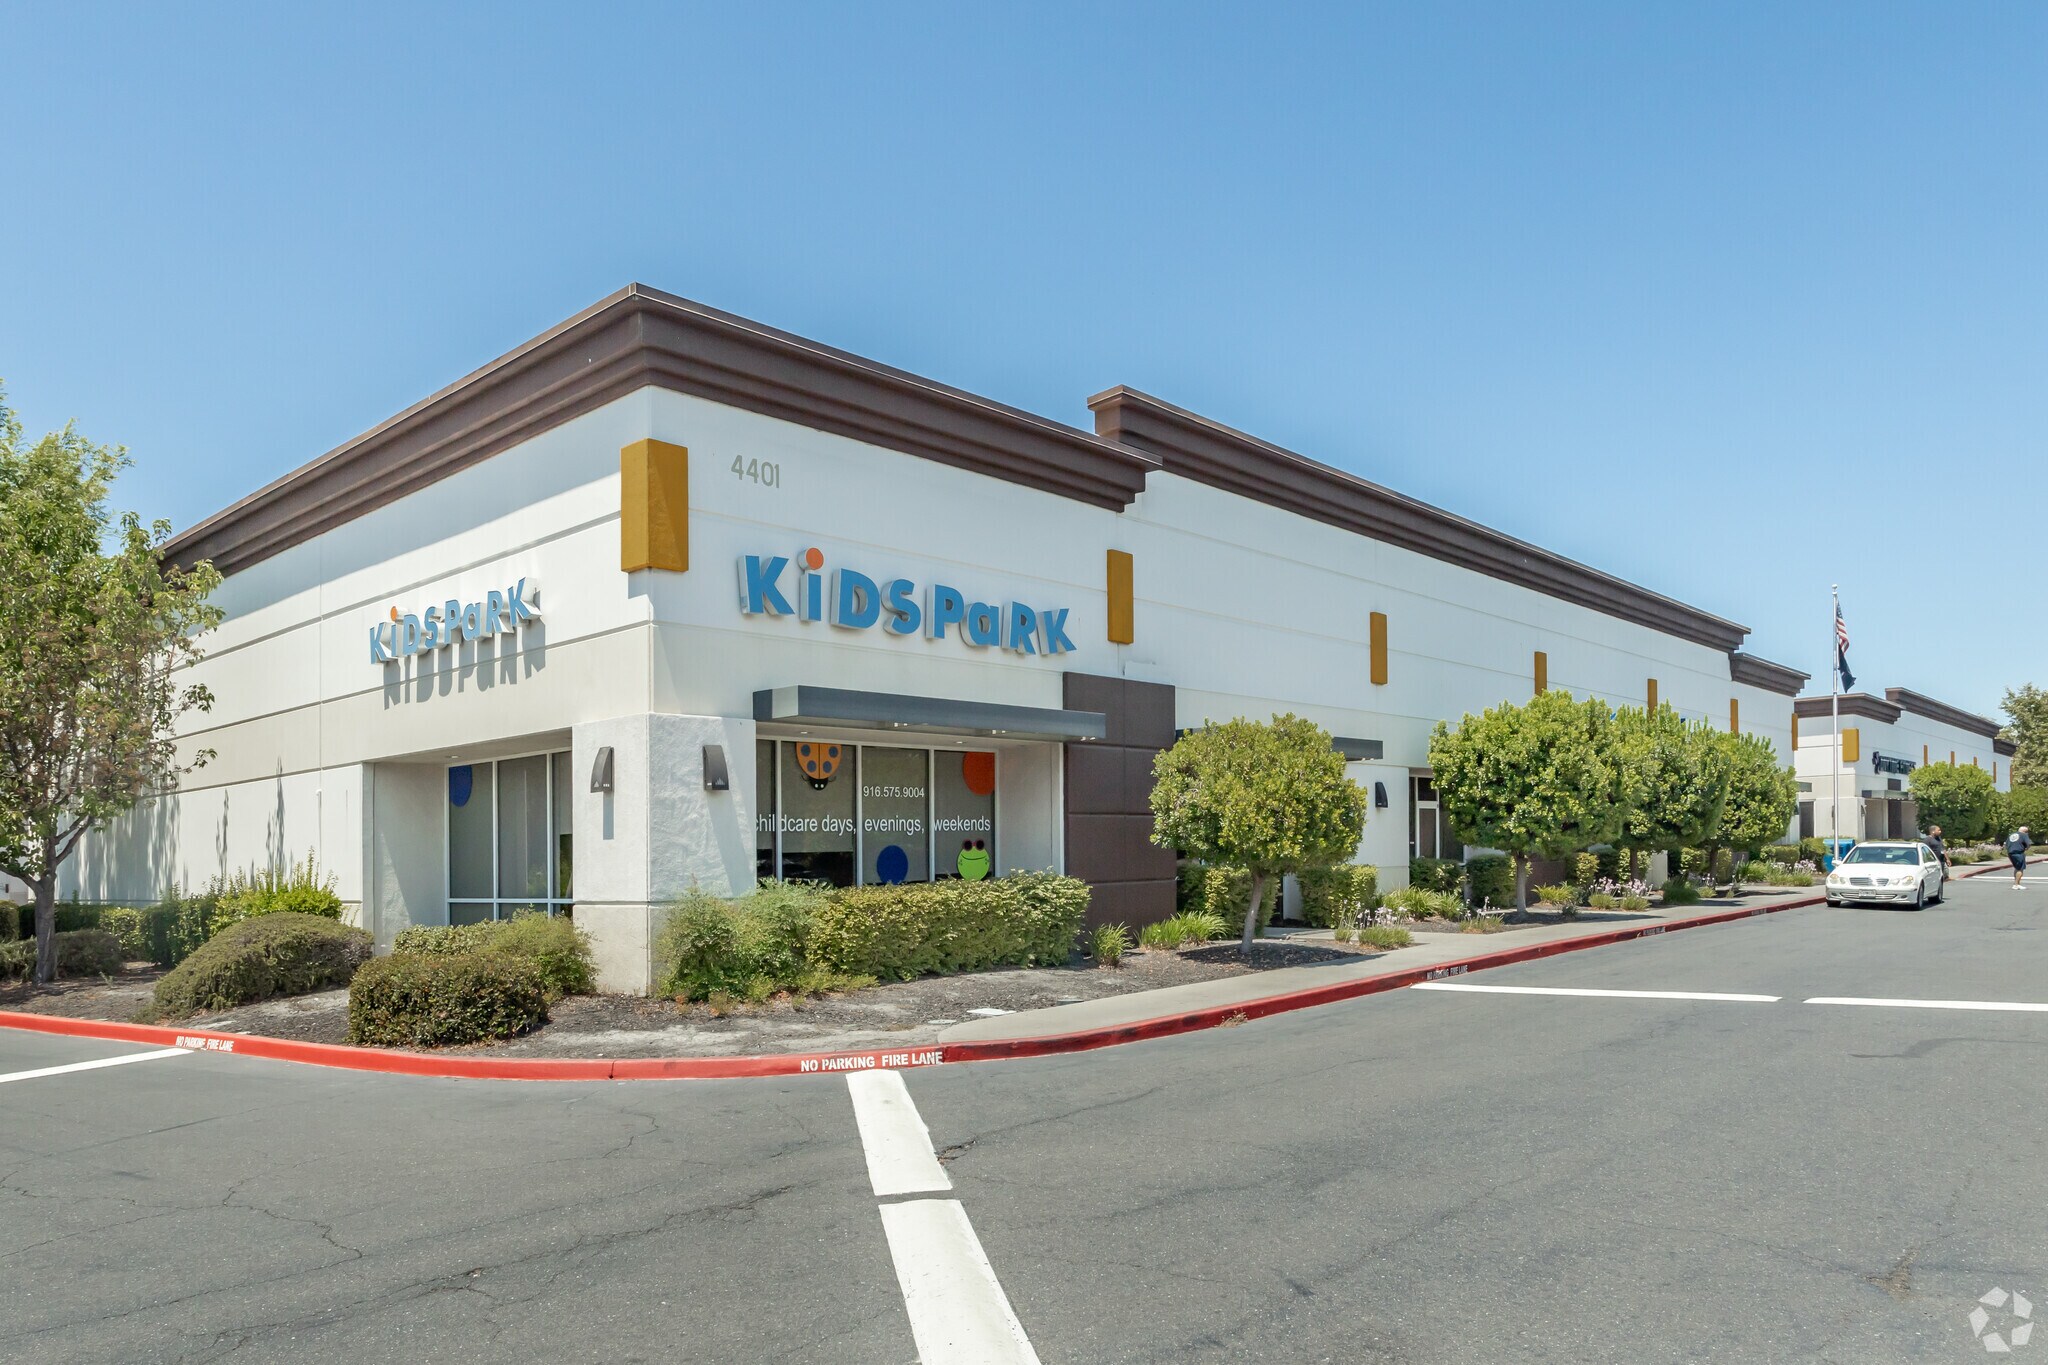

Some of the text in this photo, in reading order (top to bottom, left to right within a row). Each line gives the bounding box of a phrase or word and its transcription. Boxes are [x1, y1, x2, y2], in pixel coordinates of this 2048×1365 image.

[730, 454, 780, 489] 4401
[863, 785, 925, 798] 916.575.9004
[821, 814, 857, 836] days,
[864, 814, 925, 836] evenings,
[934, 815, 991, 832] weekends
[175, 1035, 234, 1052] NO PARKING FIRE LANE
[800, 1051, 943, 1072] NO PARKING FIRE LANE
